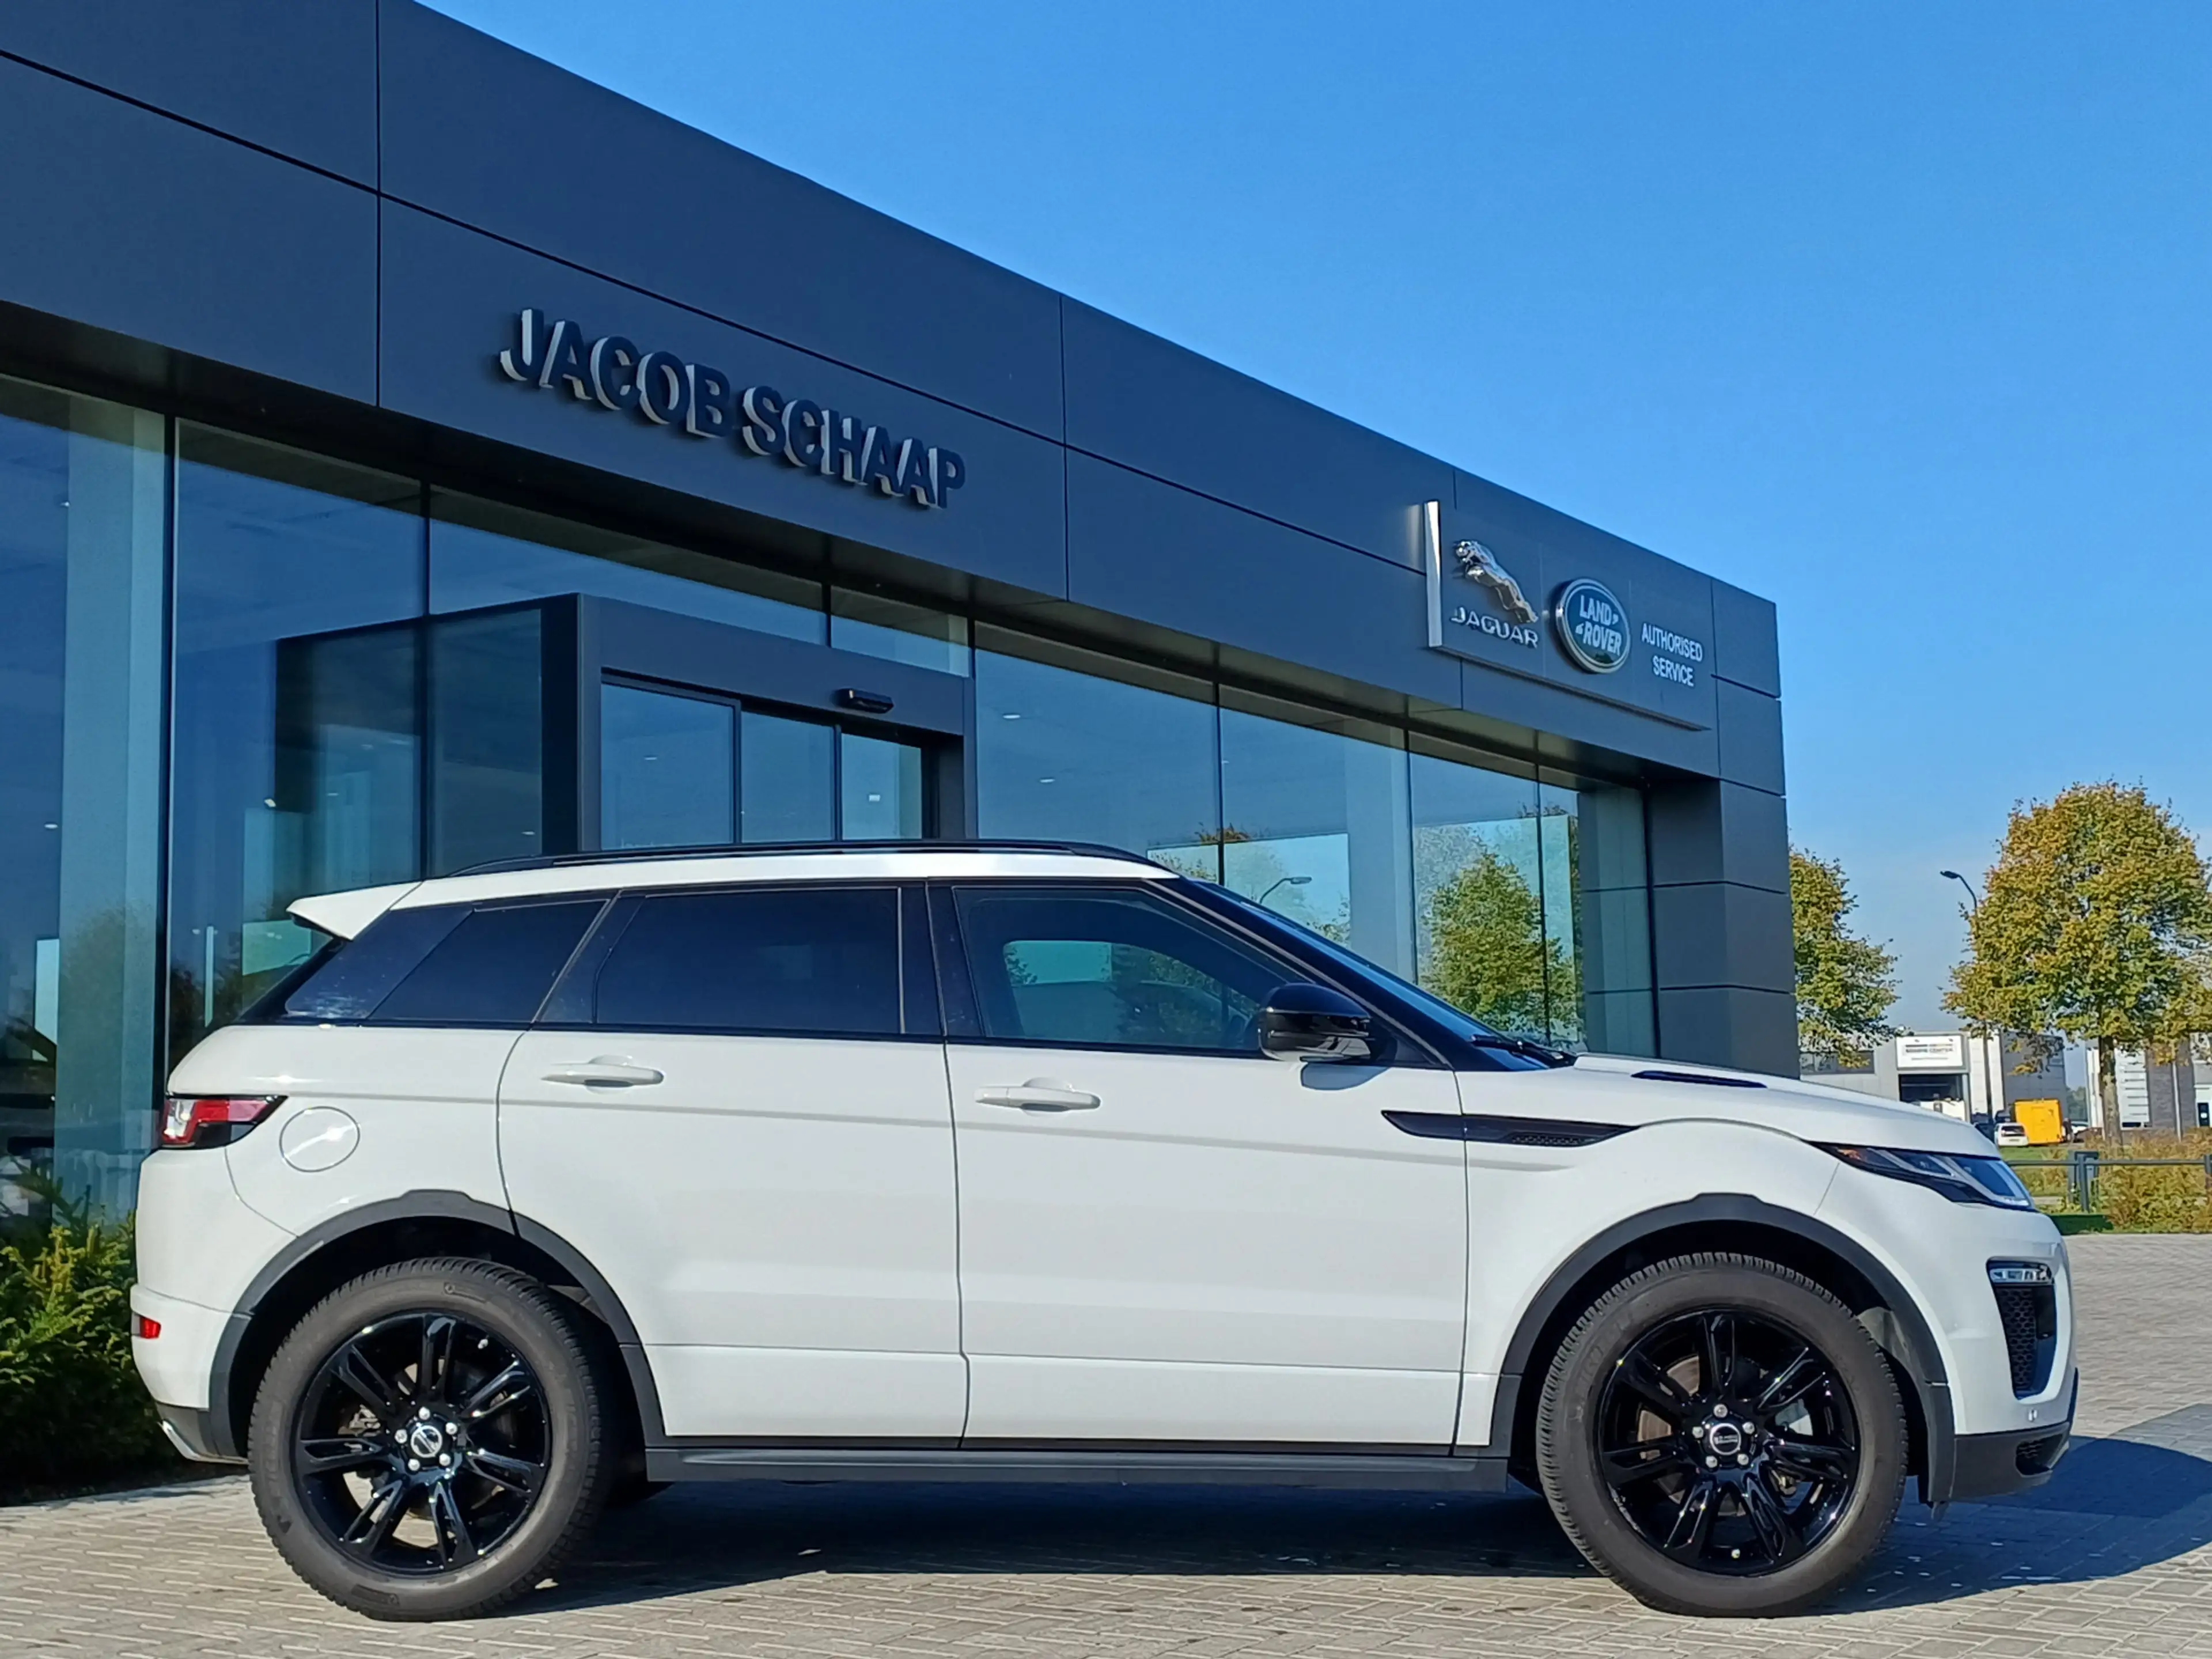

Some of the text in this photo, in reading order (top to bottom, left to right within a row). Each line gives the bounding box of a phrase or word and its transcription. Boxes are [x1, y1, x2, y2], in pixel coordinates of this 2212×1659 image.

[500, 308, 966, 510] JACOB SCHAAP
[1450, 607, 1539, 649] JAGUAR
[1580, 594, 1612, 626] LAND
[1582, 620, 1622, 656] ROVER
[1642, 623, 1703, 662] AUTHORISED
[1652, 655, 1694, 687] SERVICE
